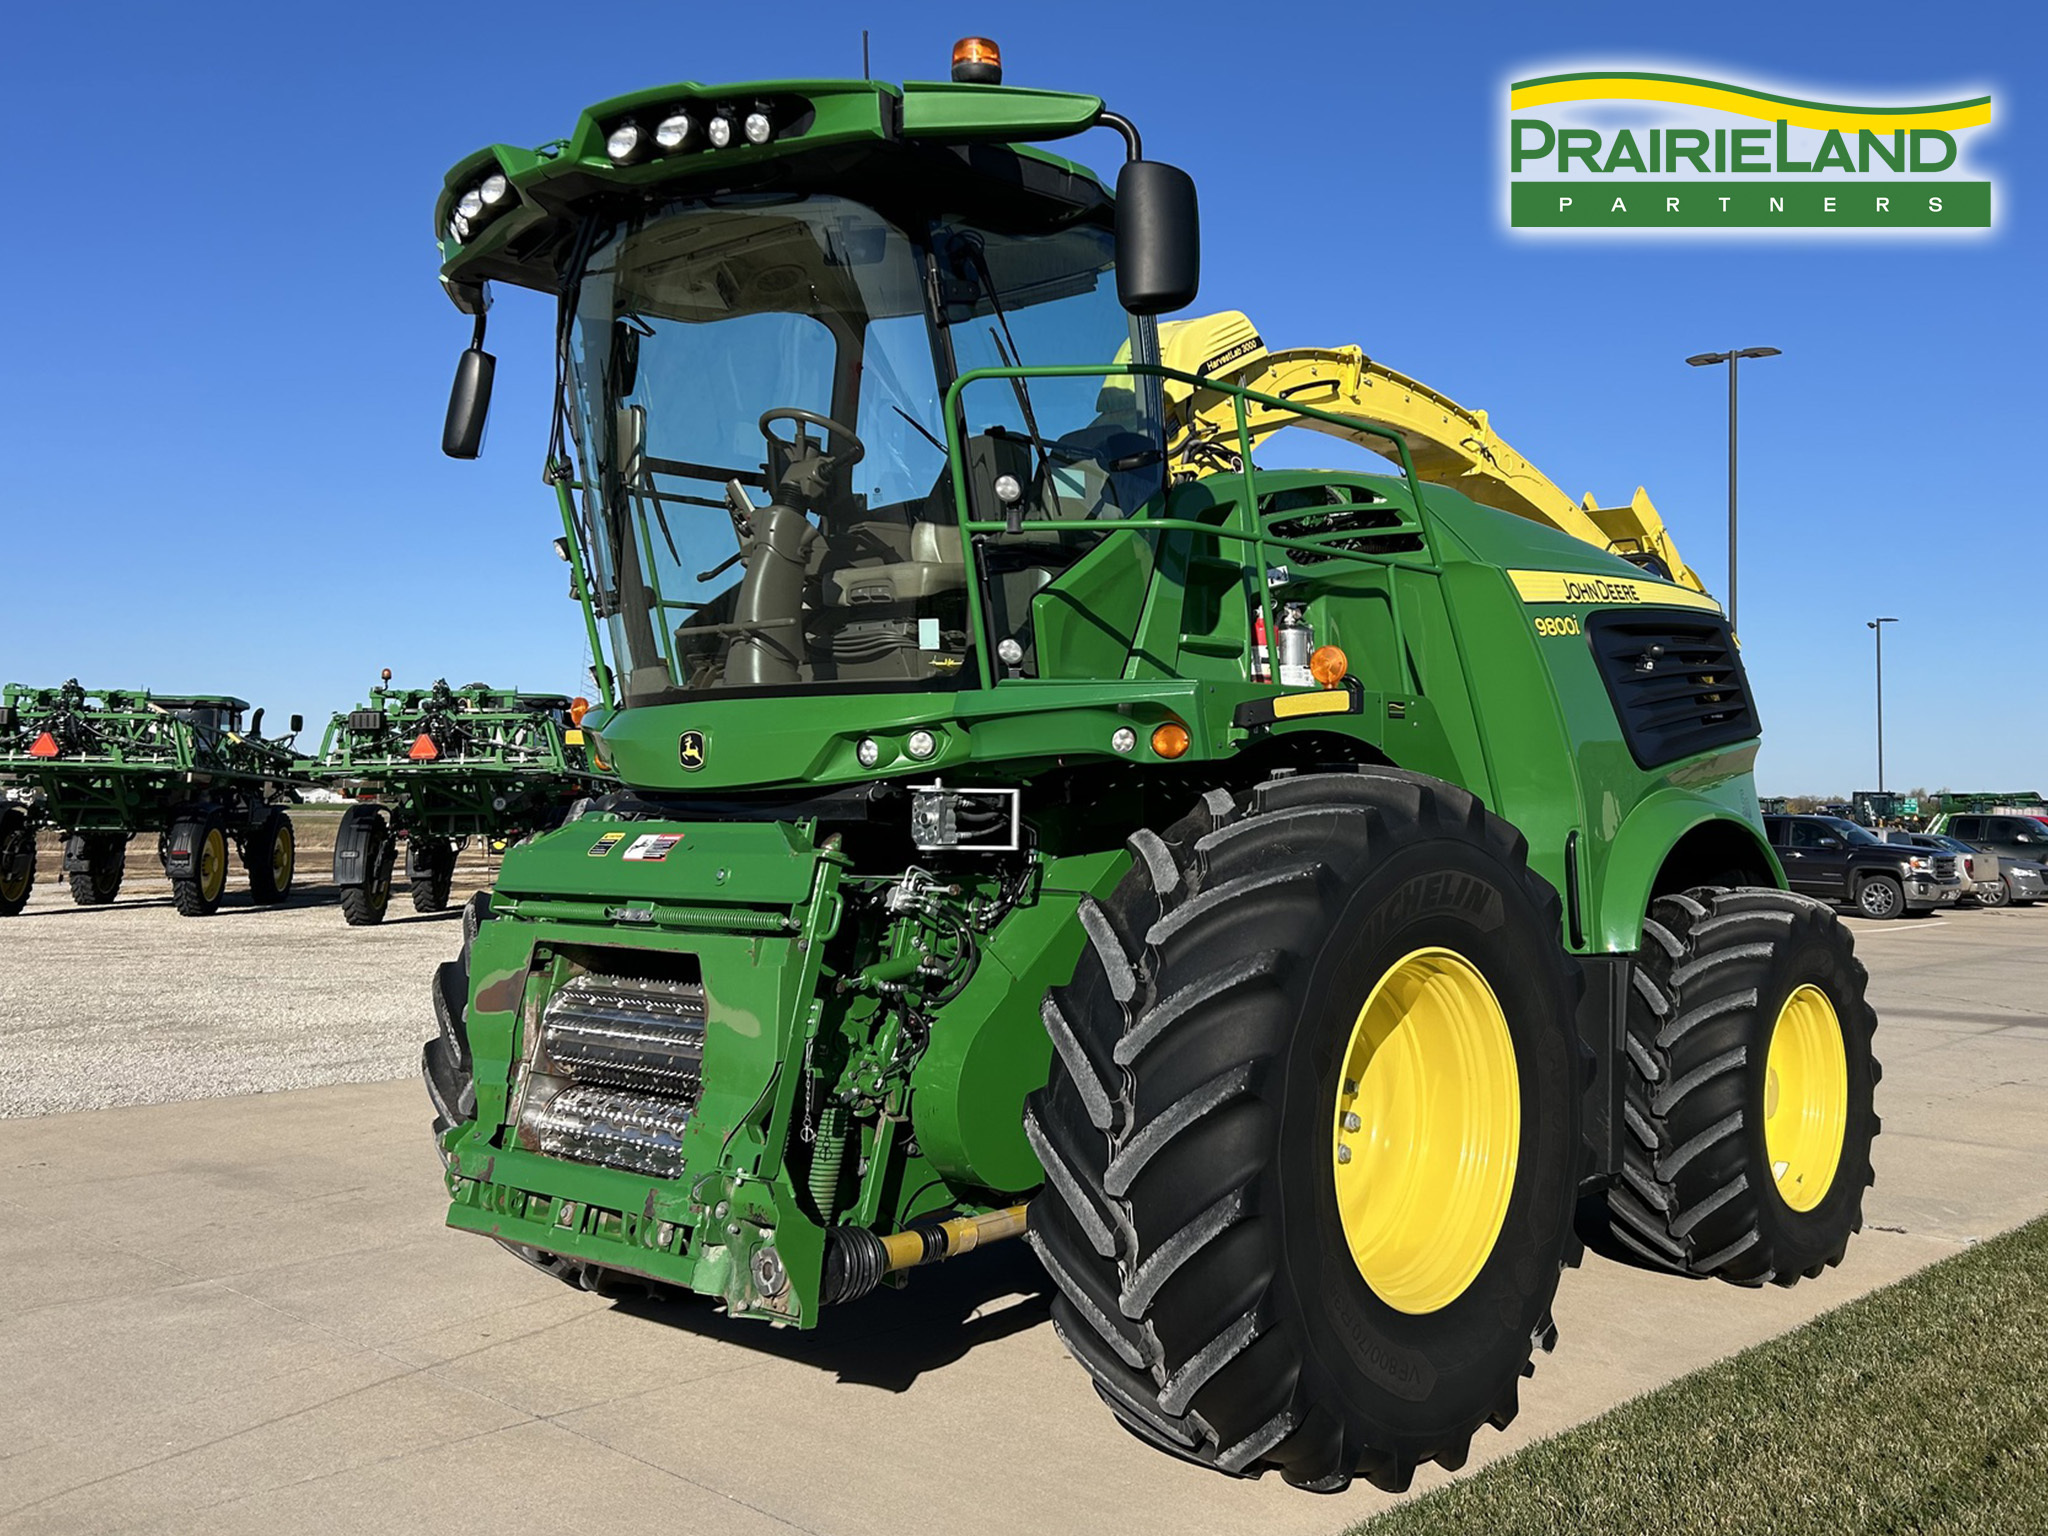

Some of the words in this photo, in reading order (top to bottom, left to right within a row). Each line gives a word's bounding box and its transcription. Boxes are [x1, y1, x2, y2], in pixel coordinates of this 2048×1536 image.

[1206, 347, 1242, 371] HarvestLab
[1241, 339, 1257, 353] 3000
[1563, 579, 1600, 600] JOHN
[1595, 579, 1640, 601] DEERE
[1534, 613, 1580, 637] 9800i
